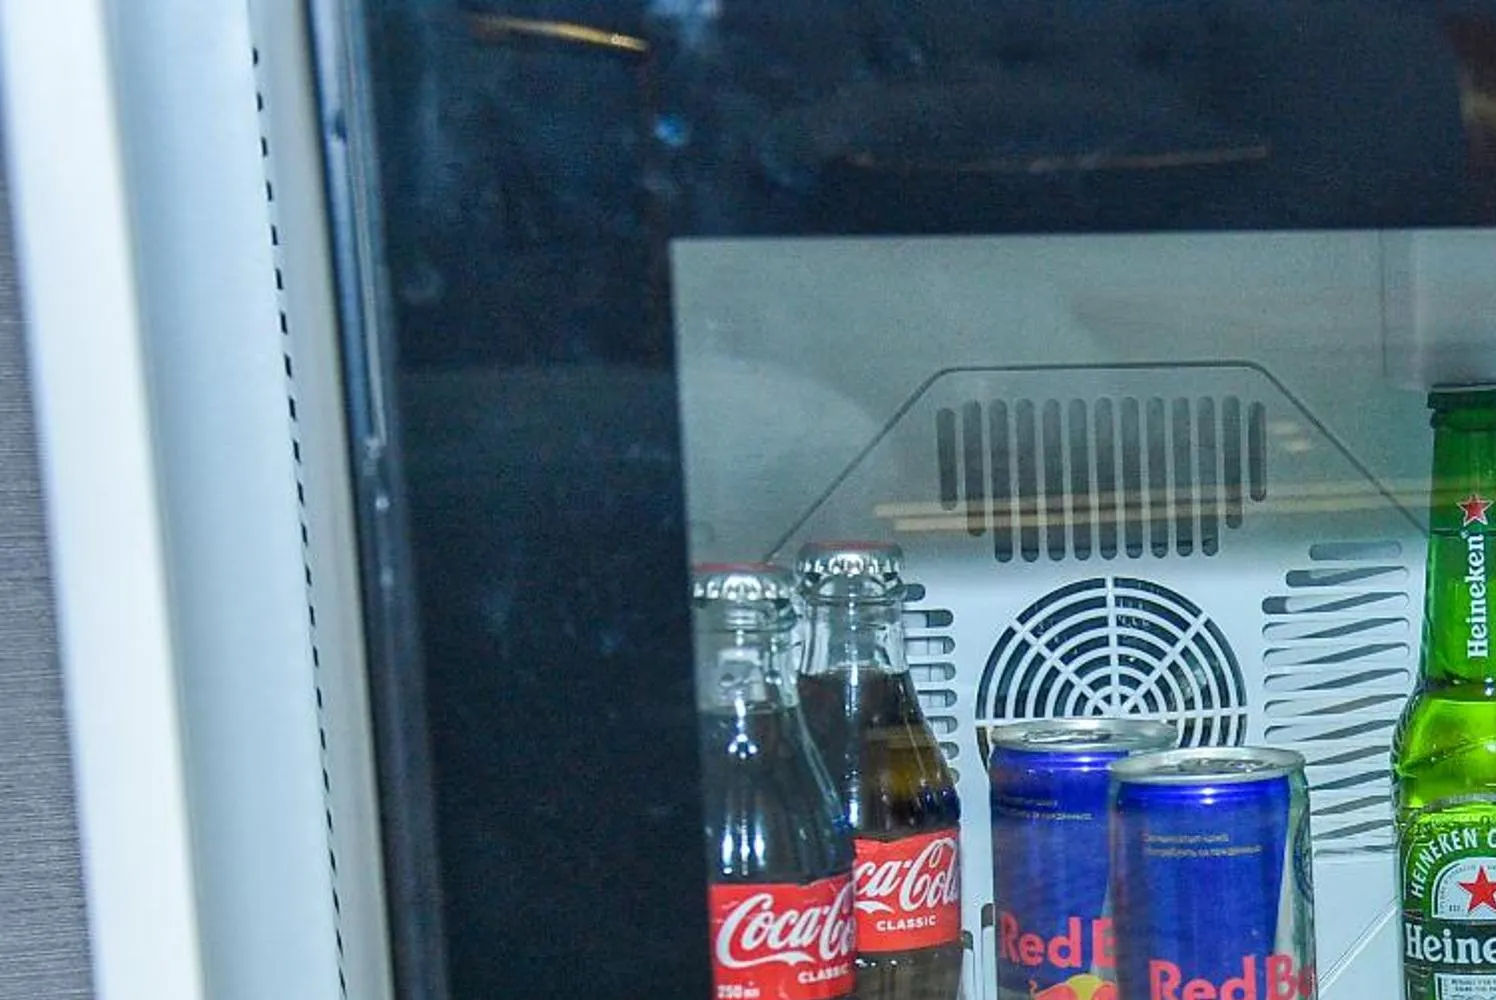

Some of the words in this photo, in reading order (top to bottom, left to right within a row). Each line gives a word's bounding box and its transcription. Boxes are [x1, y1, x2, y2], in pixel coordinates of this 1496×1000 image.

[1465, 534, 1489, 659] Heineken
[1410, 828, 1478, 897] HEINEKEN
[876, 915, 937, 932] CLASSIC
[1000, 912, 1082, 968] Red
